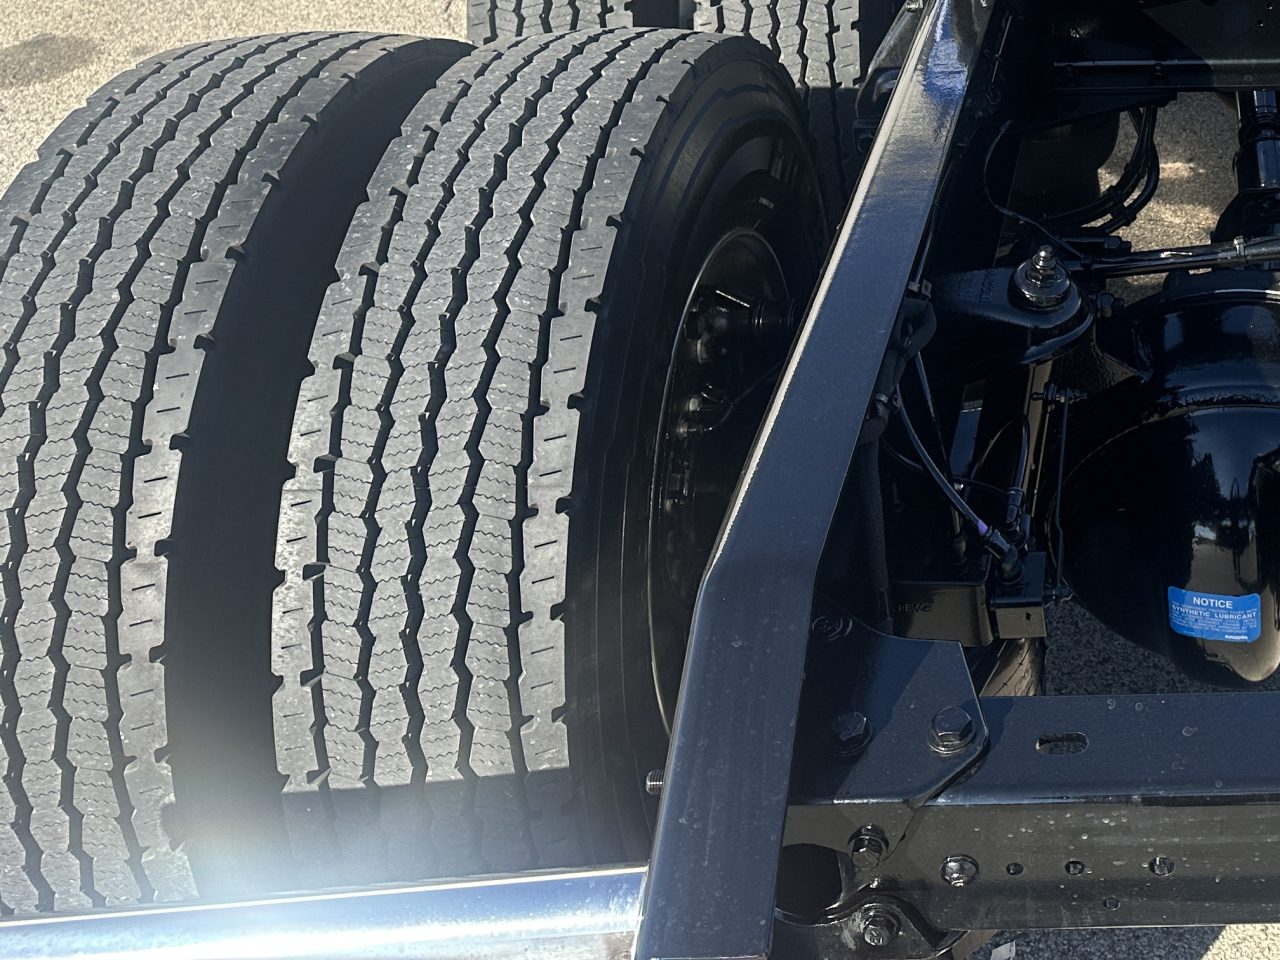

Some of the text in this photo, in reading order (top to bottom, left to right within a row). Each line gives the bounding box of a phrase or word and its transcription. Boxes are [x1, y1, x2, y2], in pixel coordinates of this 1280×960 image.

[1193, 596, 1233, 609] NOTICE
[1171, 604, 1210, 617] SYNTHETIC
[1215, 611, 1256, 620] LUBRICANT
